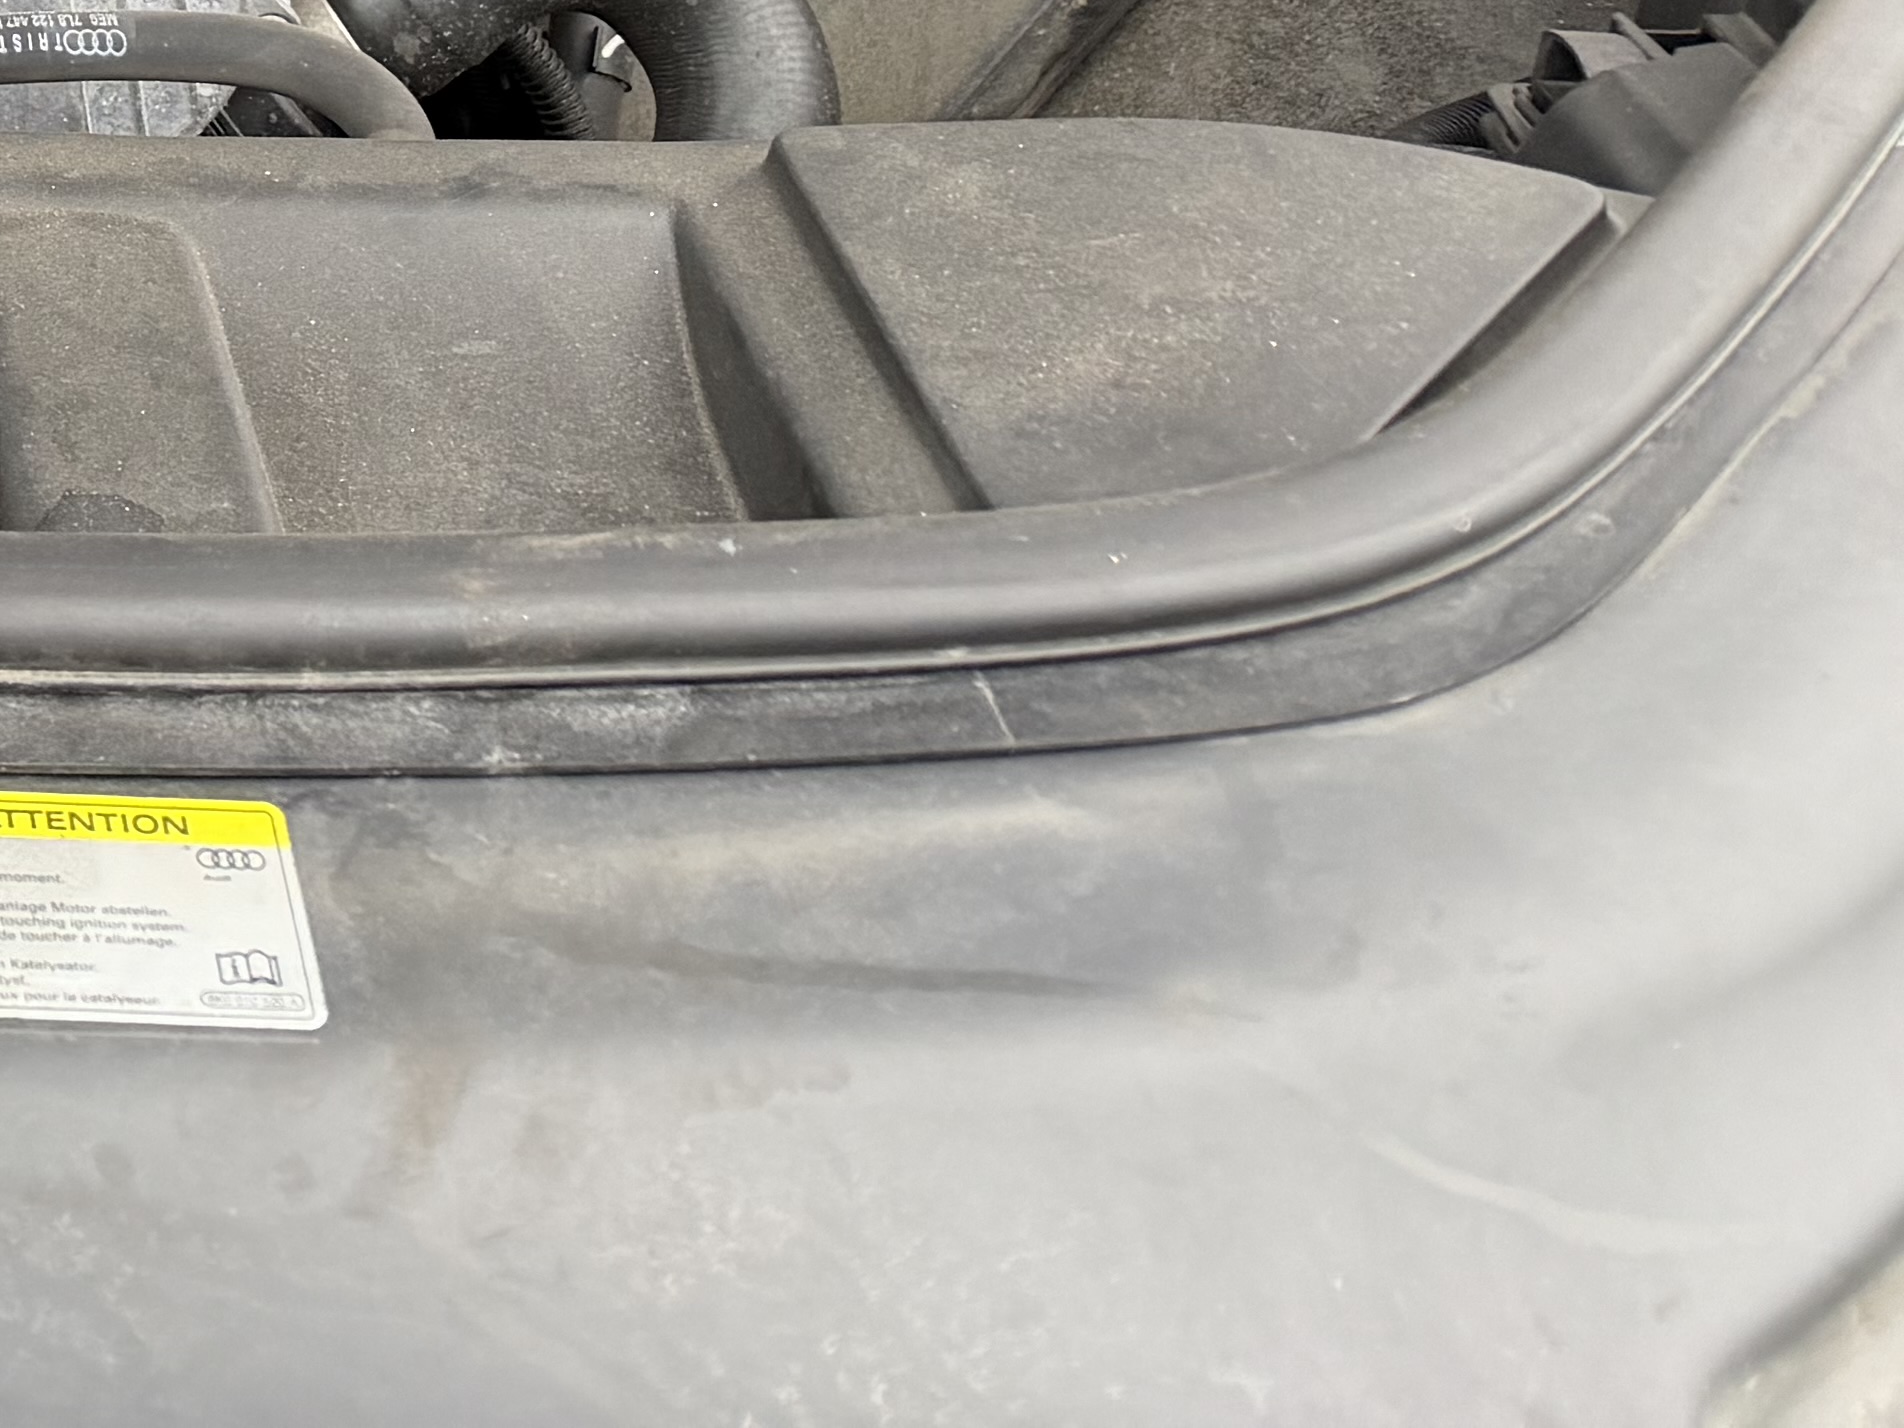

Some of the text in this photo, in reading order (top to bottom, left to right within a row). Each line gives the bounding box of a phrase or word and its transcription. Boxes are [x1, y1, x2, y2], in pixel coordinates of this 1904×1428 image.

[0, 871, 65, 885] moment.
[50, 901, 96, 915] Motor
[101, 904, 172, 918] abstellen.
[0, 915, 66, 930] touching
[70, 917, 128, 932] ignition
[20, 931, 78, 944] toucher
[24, 991, 60, 1004] pour
